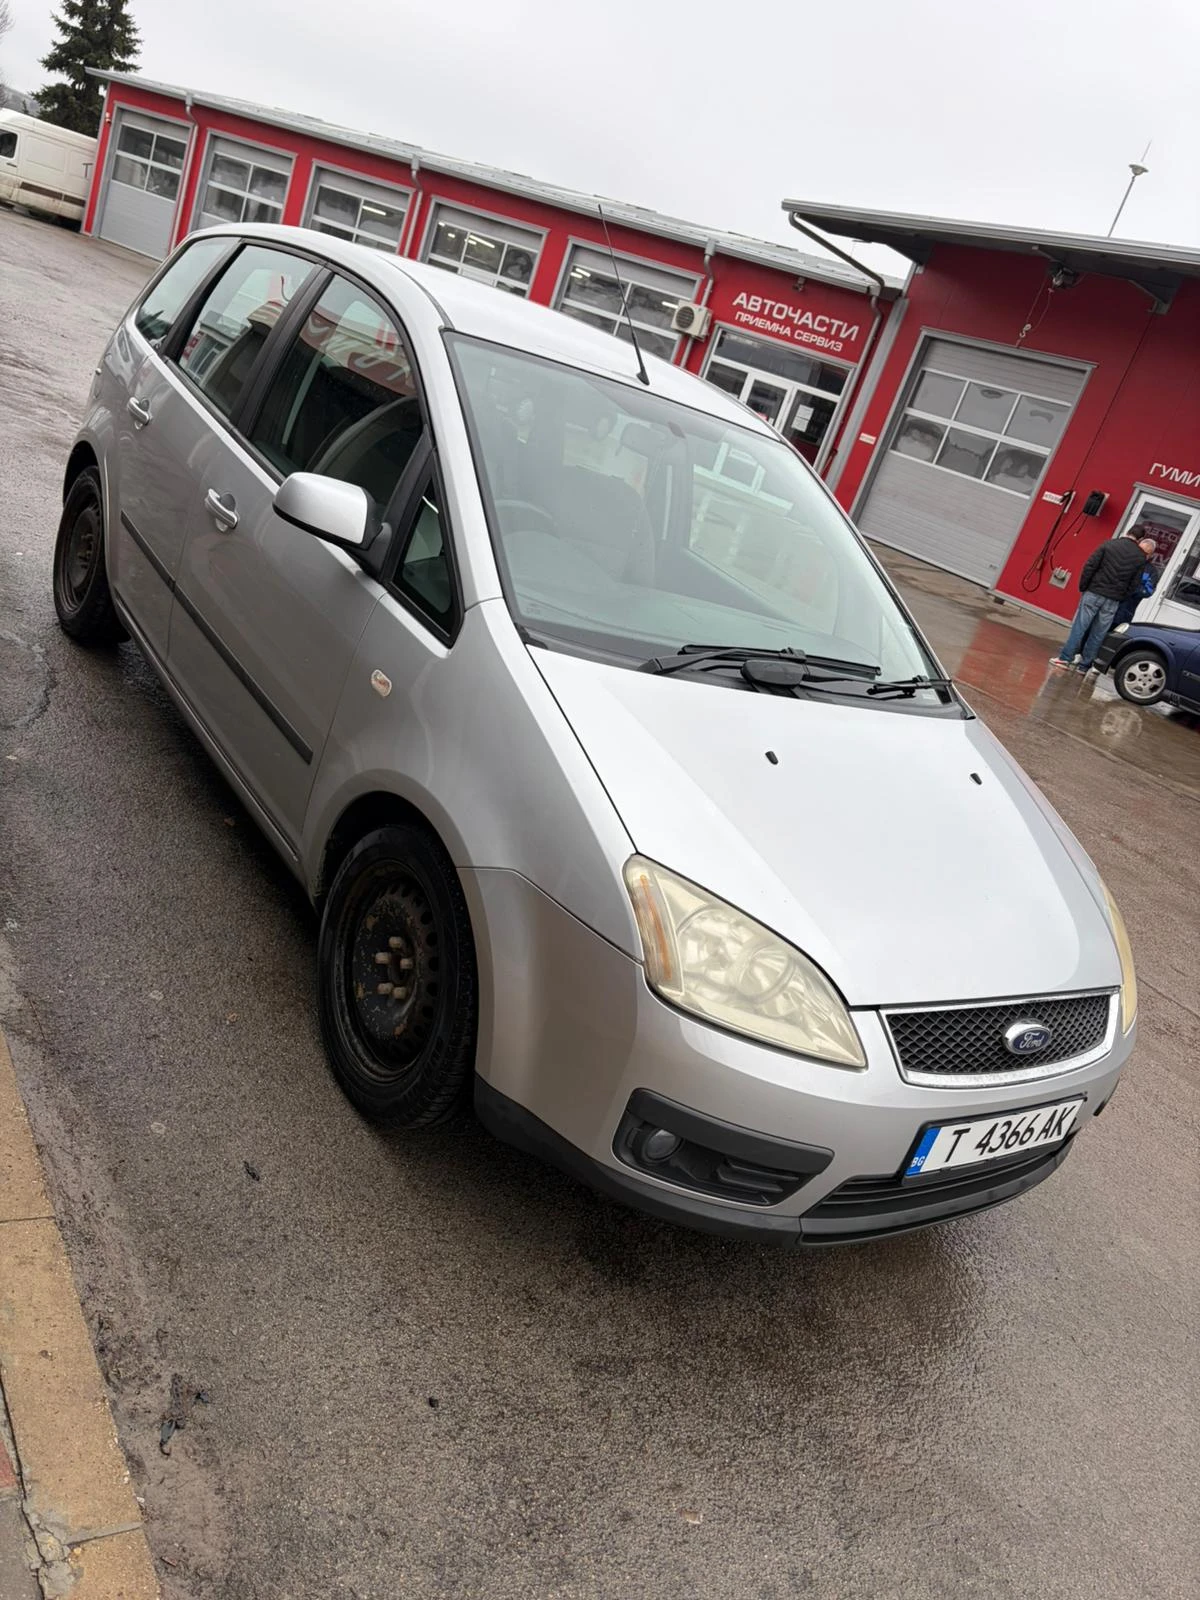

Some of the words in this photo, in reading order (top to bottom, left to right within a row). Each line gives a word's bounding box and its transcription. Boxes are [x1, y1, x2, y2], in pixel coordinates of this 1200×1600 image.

[732, 292, 859, 341] АВТОЧАСТИ
[735, 311, 791, 337] ПРИЕМНА
[794, 329, 843, 352] СЕРВИЗ
[1149, 462, 1200, 487] ГУМИ
[1019, 1032, 1044, 1049] Ford
[910, 1155, 925, 1167] BG
